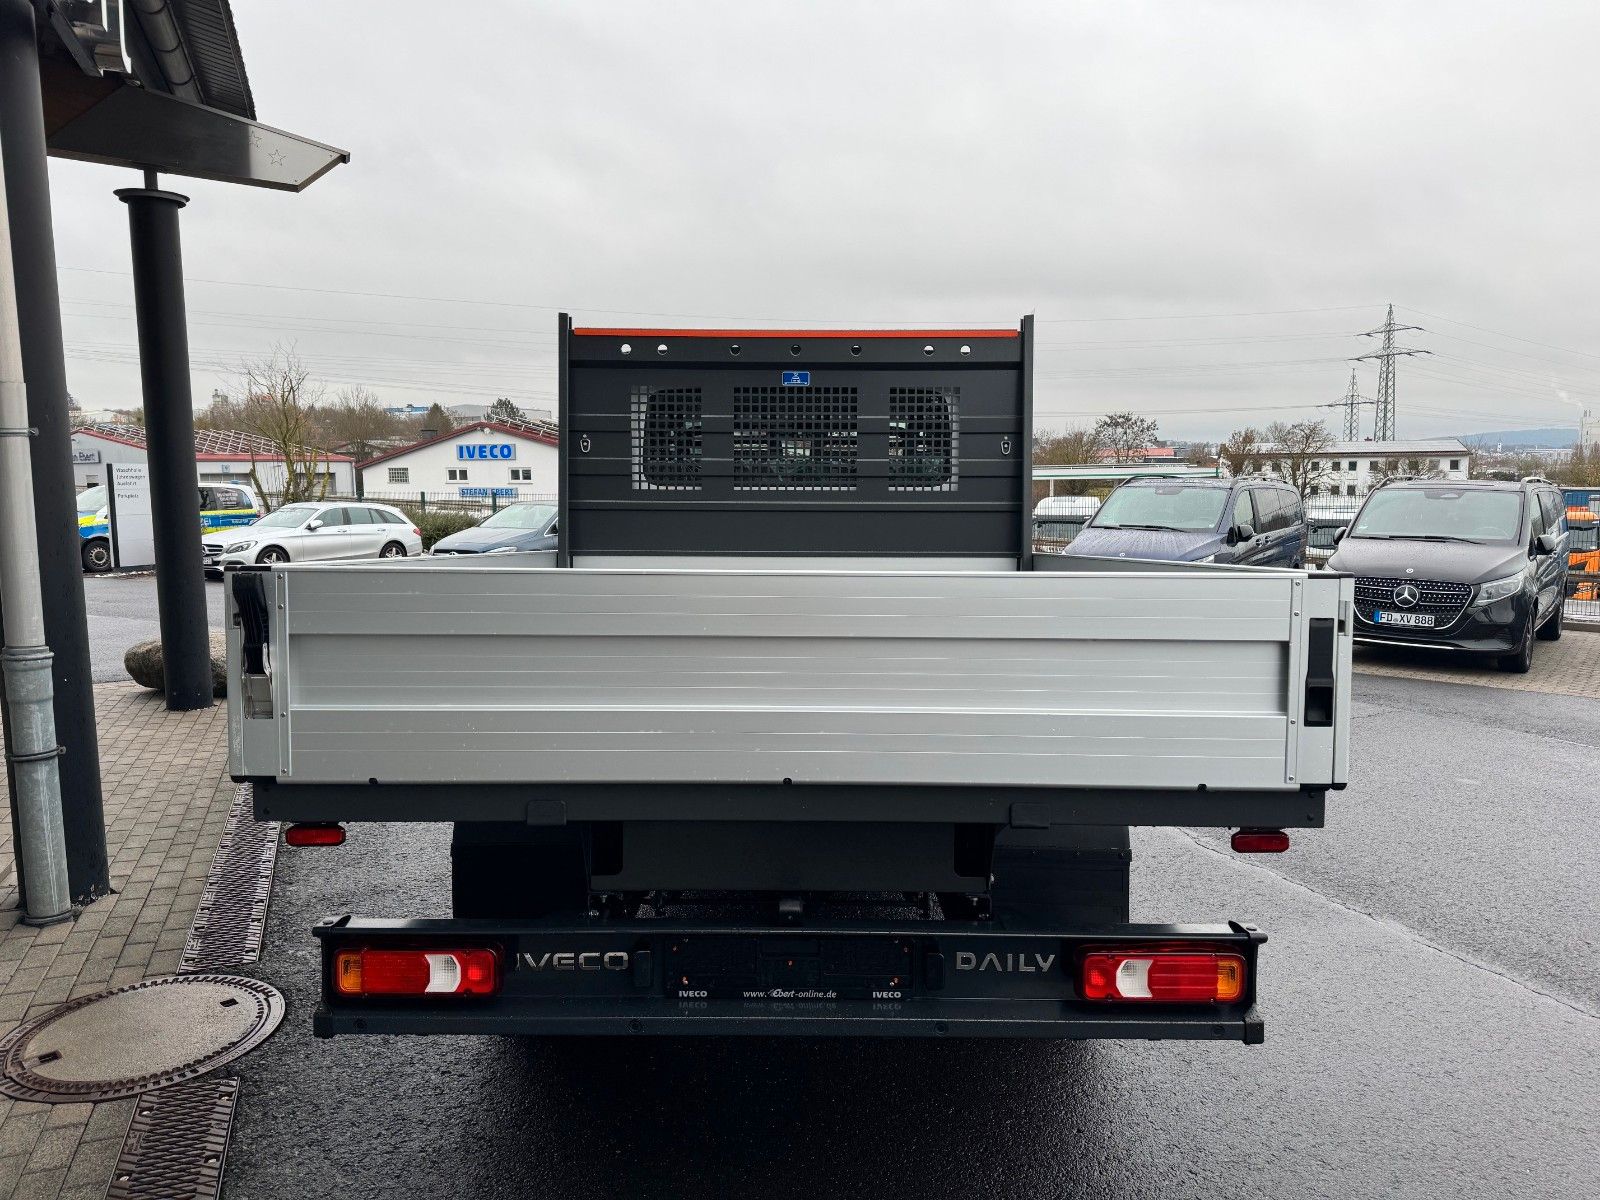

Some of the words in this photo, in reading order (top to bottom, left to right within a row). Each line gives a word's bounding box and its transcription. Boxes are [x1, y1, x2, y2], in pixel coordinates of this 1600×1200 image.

[459, 444, 512, 459] IVECO
[1380, 612, 1393, 622] FD
[1399, 614, 1412, 623] XV
[1414, 615, 1434, 626] 888
[515, 951, 629, 971] IVECO
[956, 951, 1056, 973] DAILY
